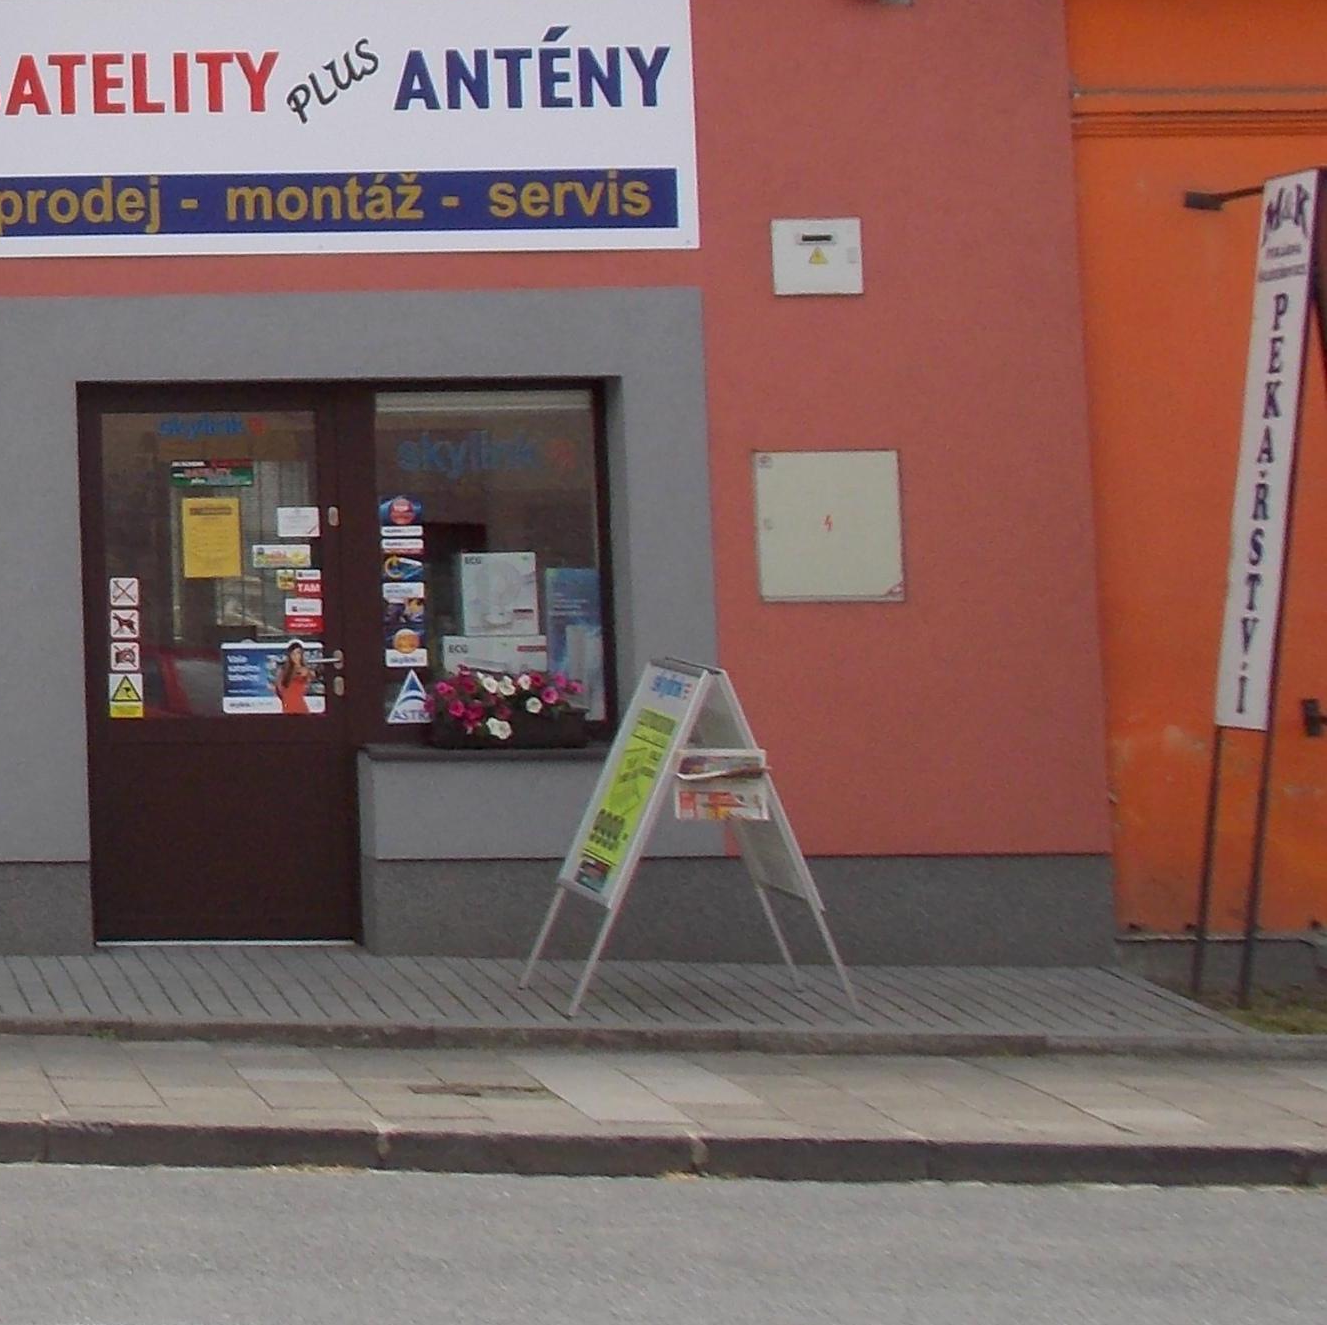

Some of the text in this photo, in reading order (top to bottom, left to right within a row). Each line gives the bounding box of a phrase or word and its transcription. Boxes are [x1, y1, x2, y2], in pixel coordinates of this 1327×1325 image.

[286, 38, 379, 123] PLUS
[393, 25, 671, 111] ANTÉNY
[226, 174, 424, 222] montáž
[488, 169, 653, 219] servis
[1236, 292, 1289, 715] PEKAŘSTVÍ
